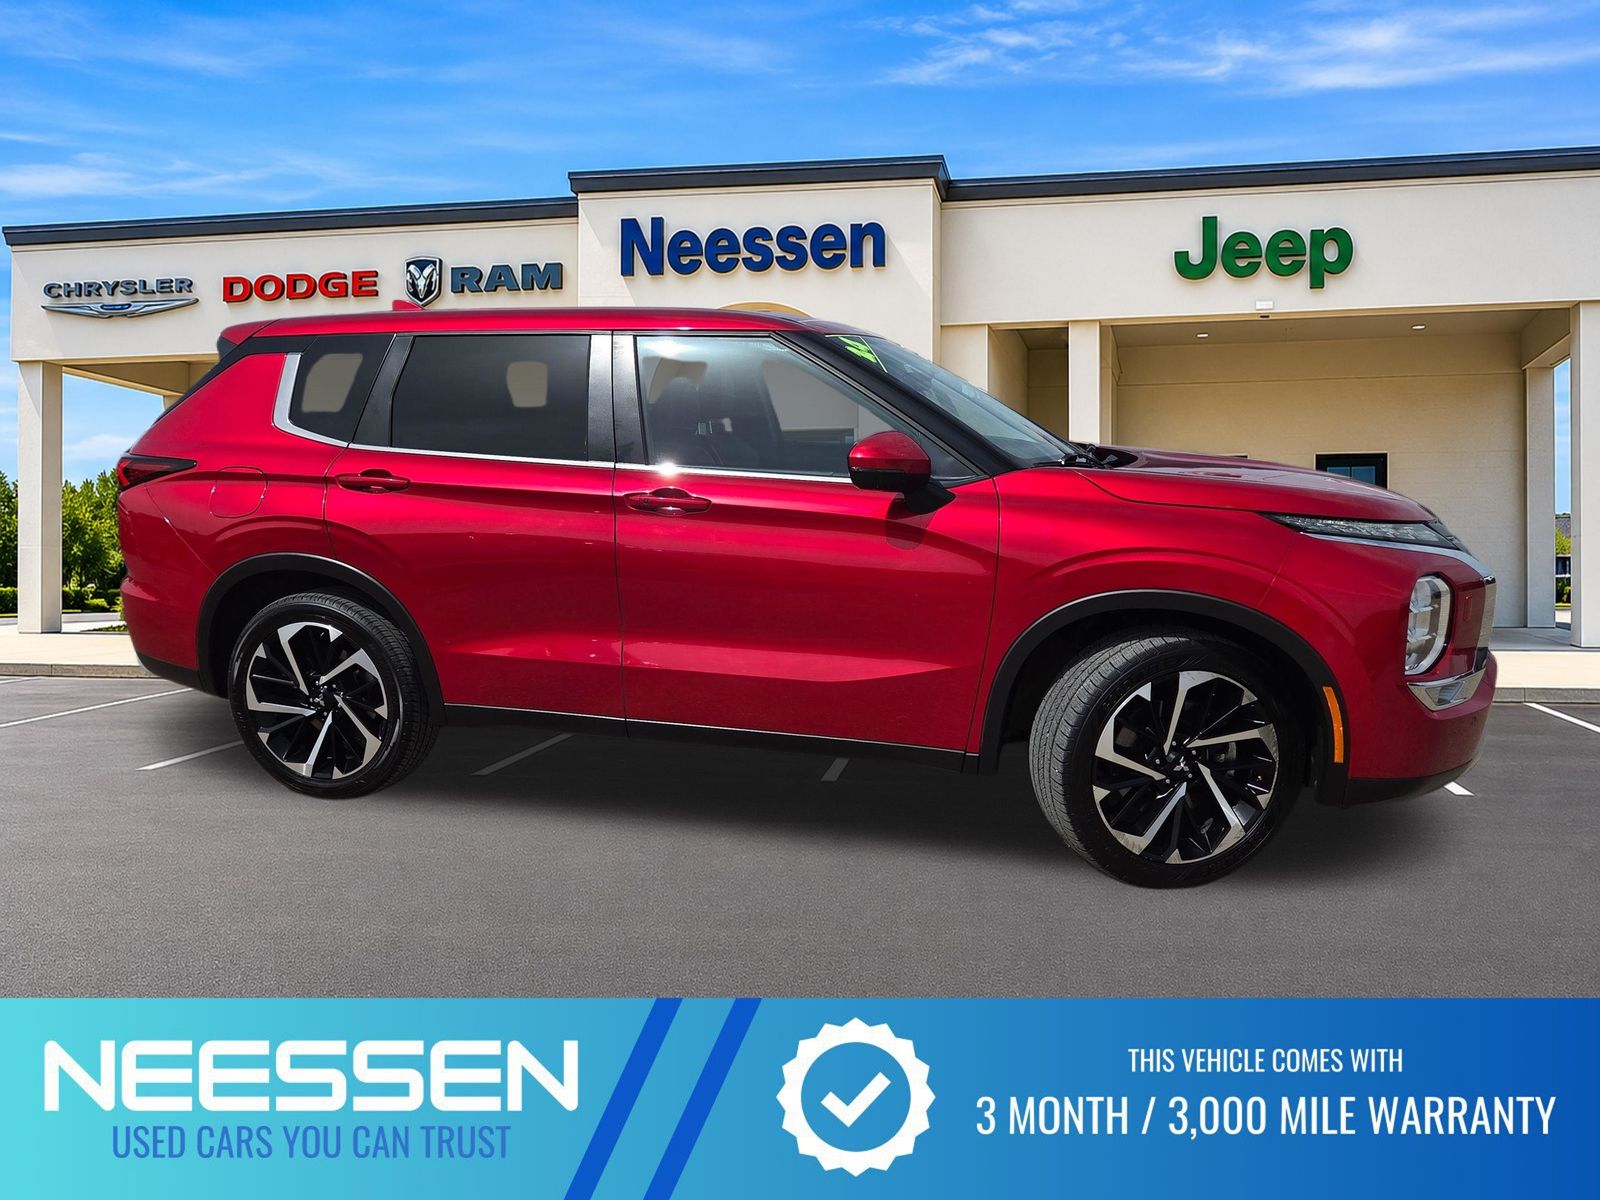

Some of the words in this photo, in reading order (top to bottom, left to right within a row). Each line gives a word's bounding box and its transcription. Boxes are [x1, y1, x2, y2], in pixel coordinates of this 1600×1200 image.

[620, 216, 886, 277] Neessen
[1174, 215, 1354, 290] Jeep
[43, 276, 194, 298] CHRYSLER
[222, 270, 379, 303] DODGE
[450, 262, 563, 294] RAM
